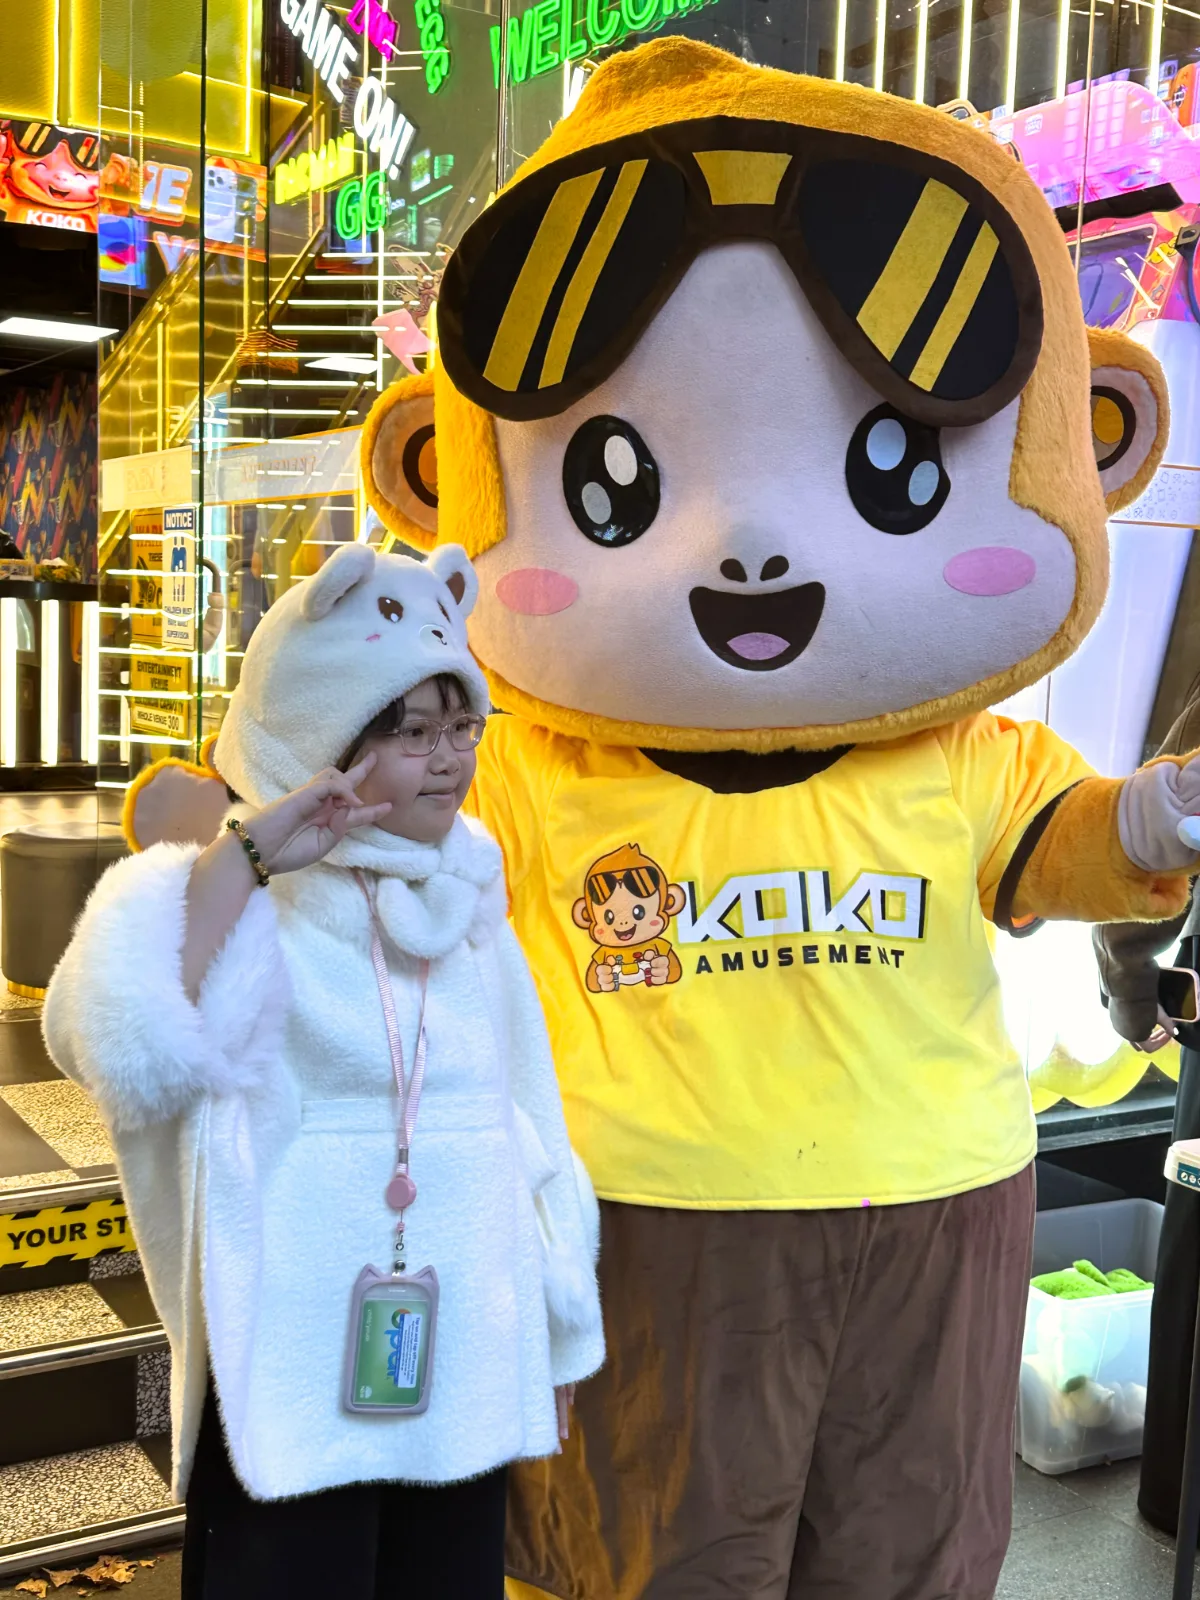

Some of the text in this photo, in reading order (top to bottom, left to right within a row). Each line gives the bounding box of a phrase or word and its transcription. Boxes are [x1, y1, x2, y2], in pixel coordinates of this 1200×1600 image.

[489, 0, 702, 89] WELC
[280, 0, 358, 103] GAME
[353, 76, 417, 181] ON!
[335, 171, 386, 240] GG
[166, 512, 192, 528] NOTICE
[167, 715, 180, 731] 300
[675, 868, 929, 945] KOKO
[696, 944, 905, 975] AMUSEMENT
[7, 1222, 88, 1251] YOUR
